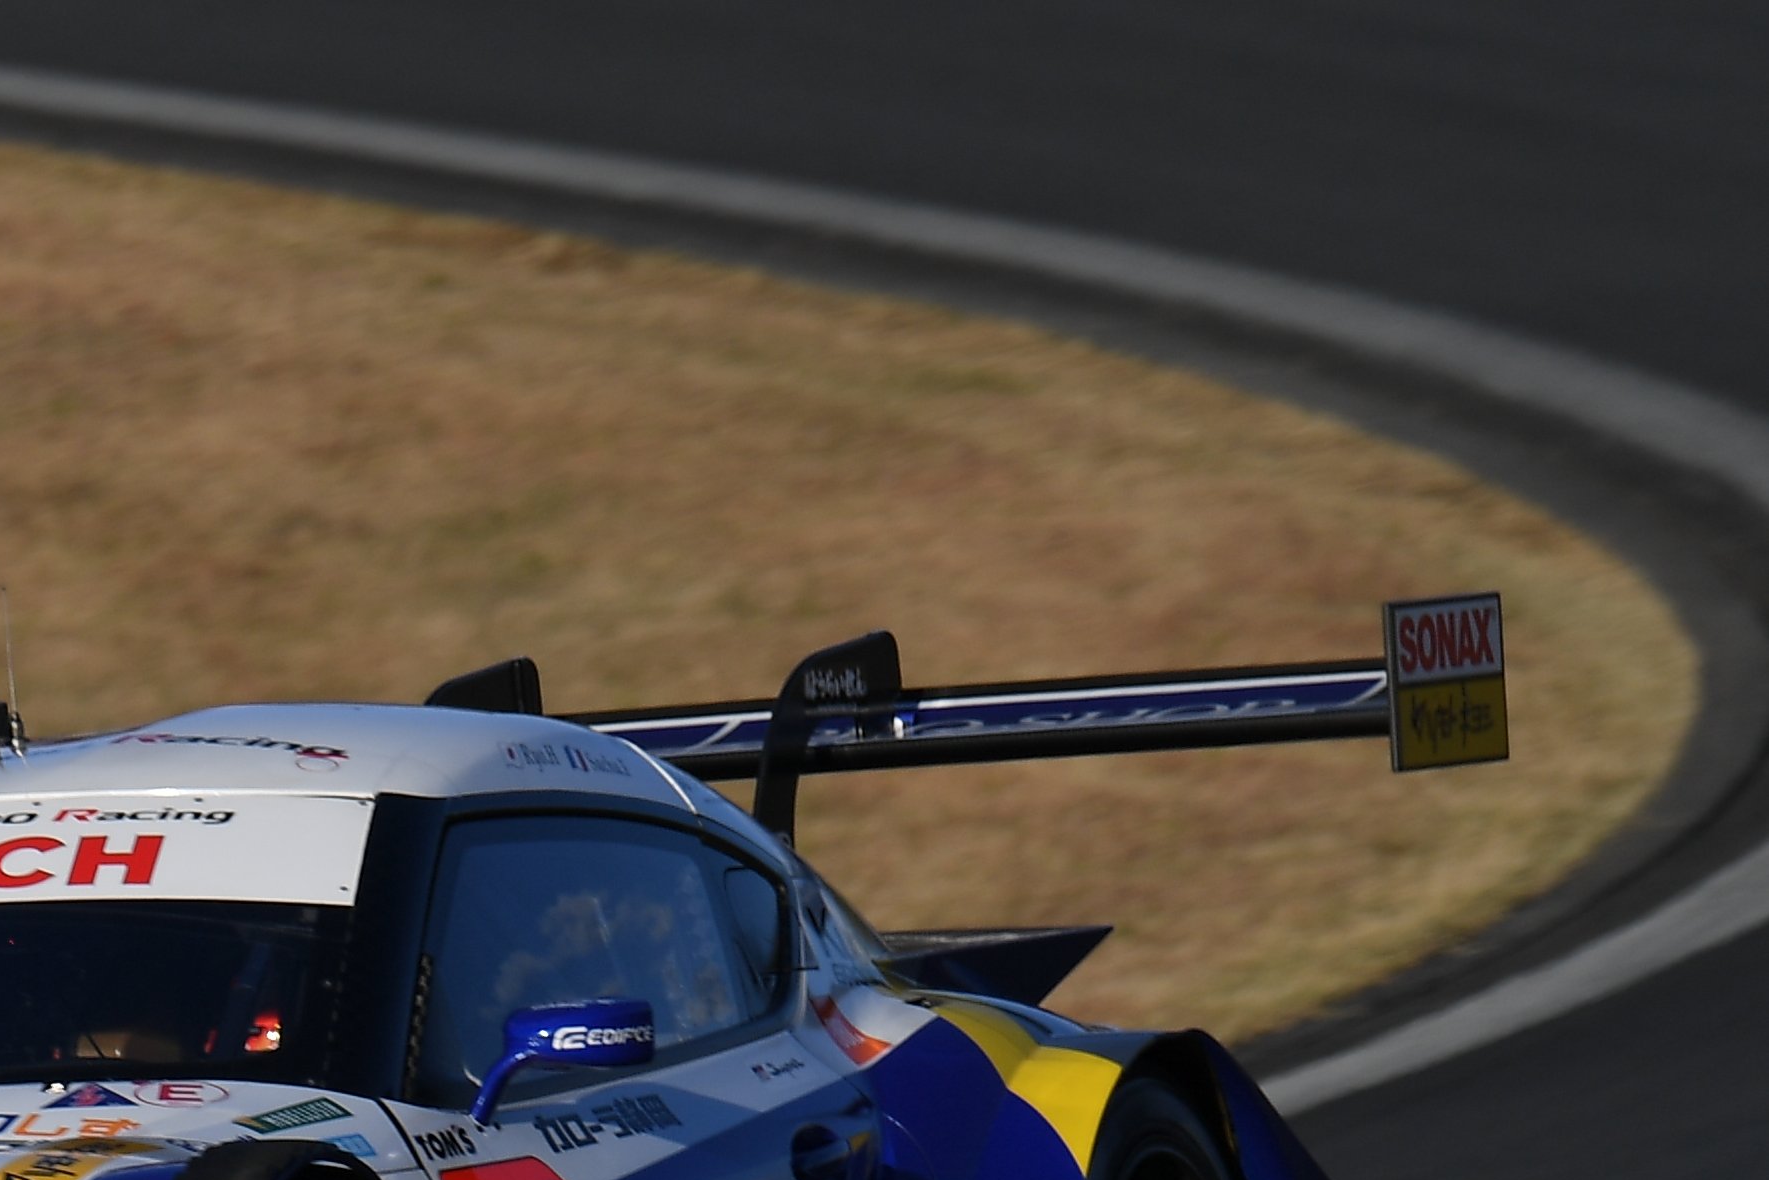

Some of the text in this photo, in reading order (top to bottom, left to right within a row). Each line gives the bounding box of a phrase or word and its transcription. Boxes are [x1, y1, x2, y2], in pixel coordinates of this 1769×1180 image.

[1399, 607, 1494, 673] SONAX
[52, 807, 235, 826] Racing
[158, 1083, 204, 1102] E
[414, 1124, 477, 1161] TOM'S
